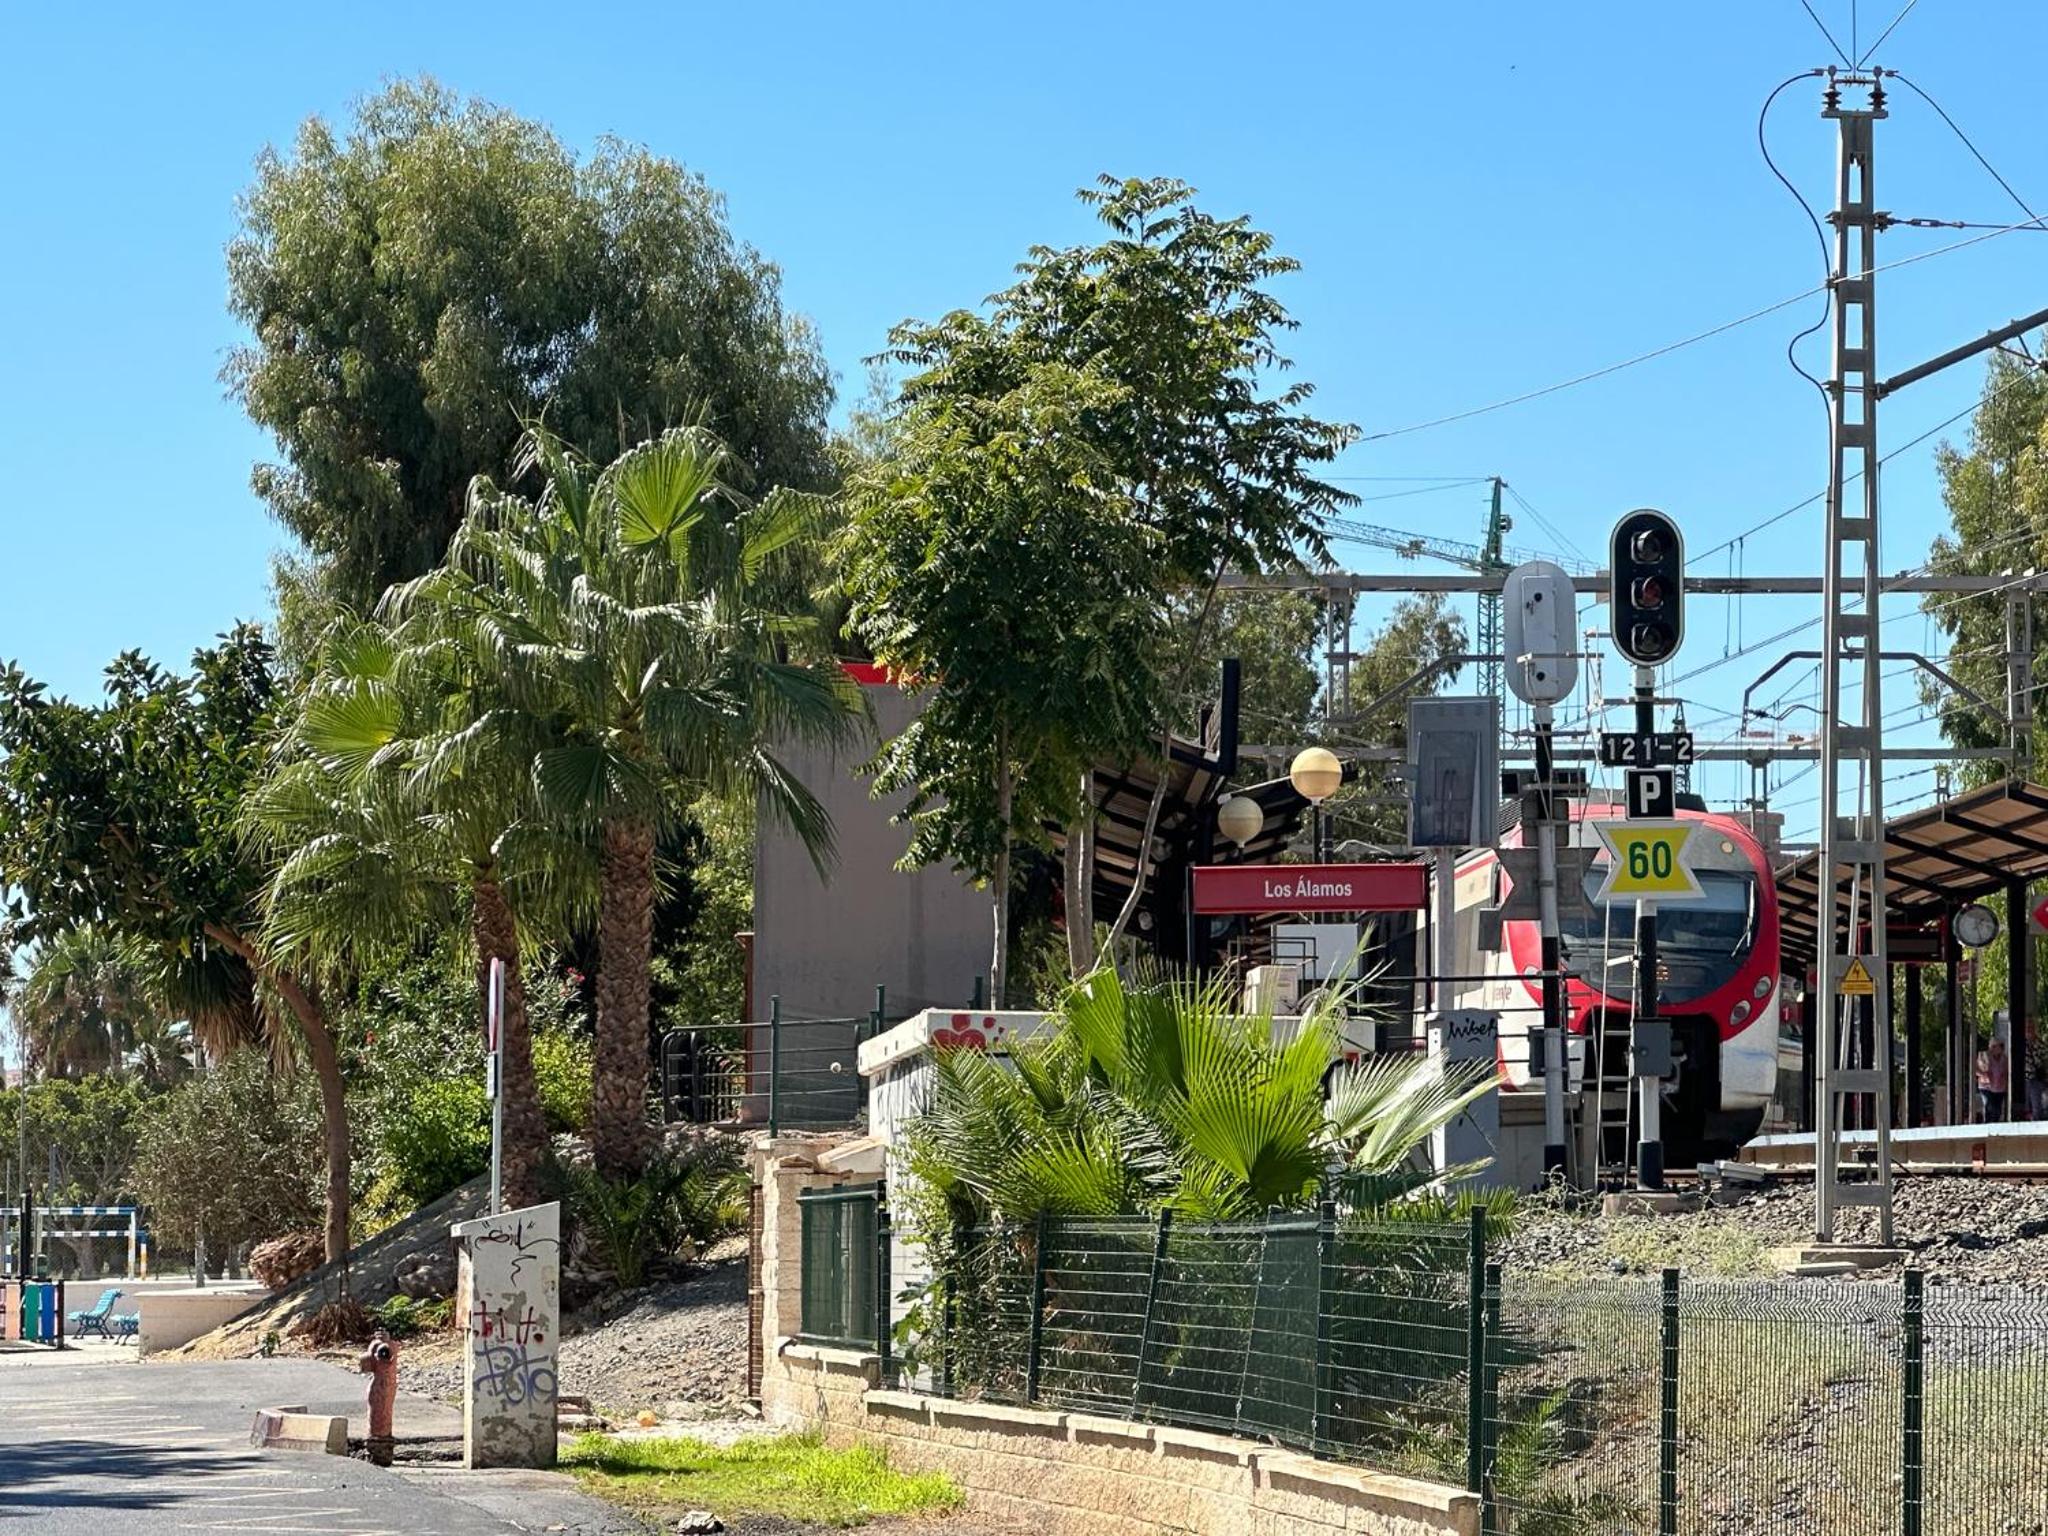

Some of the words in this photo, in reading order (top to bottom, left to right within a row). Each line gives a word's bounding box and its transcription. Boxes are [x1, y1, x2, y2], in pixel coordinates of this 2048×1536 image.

[1639, 775, 1661, 814] P
[1628, 840, 1672, 879] 60
[1264, 880, 1292, 898] Los
[1295, 874, 1353, 897] Álamos
